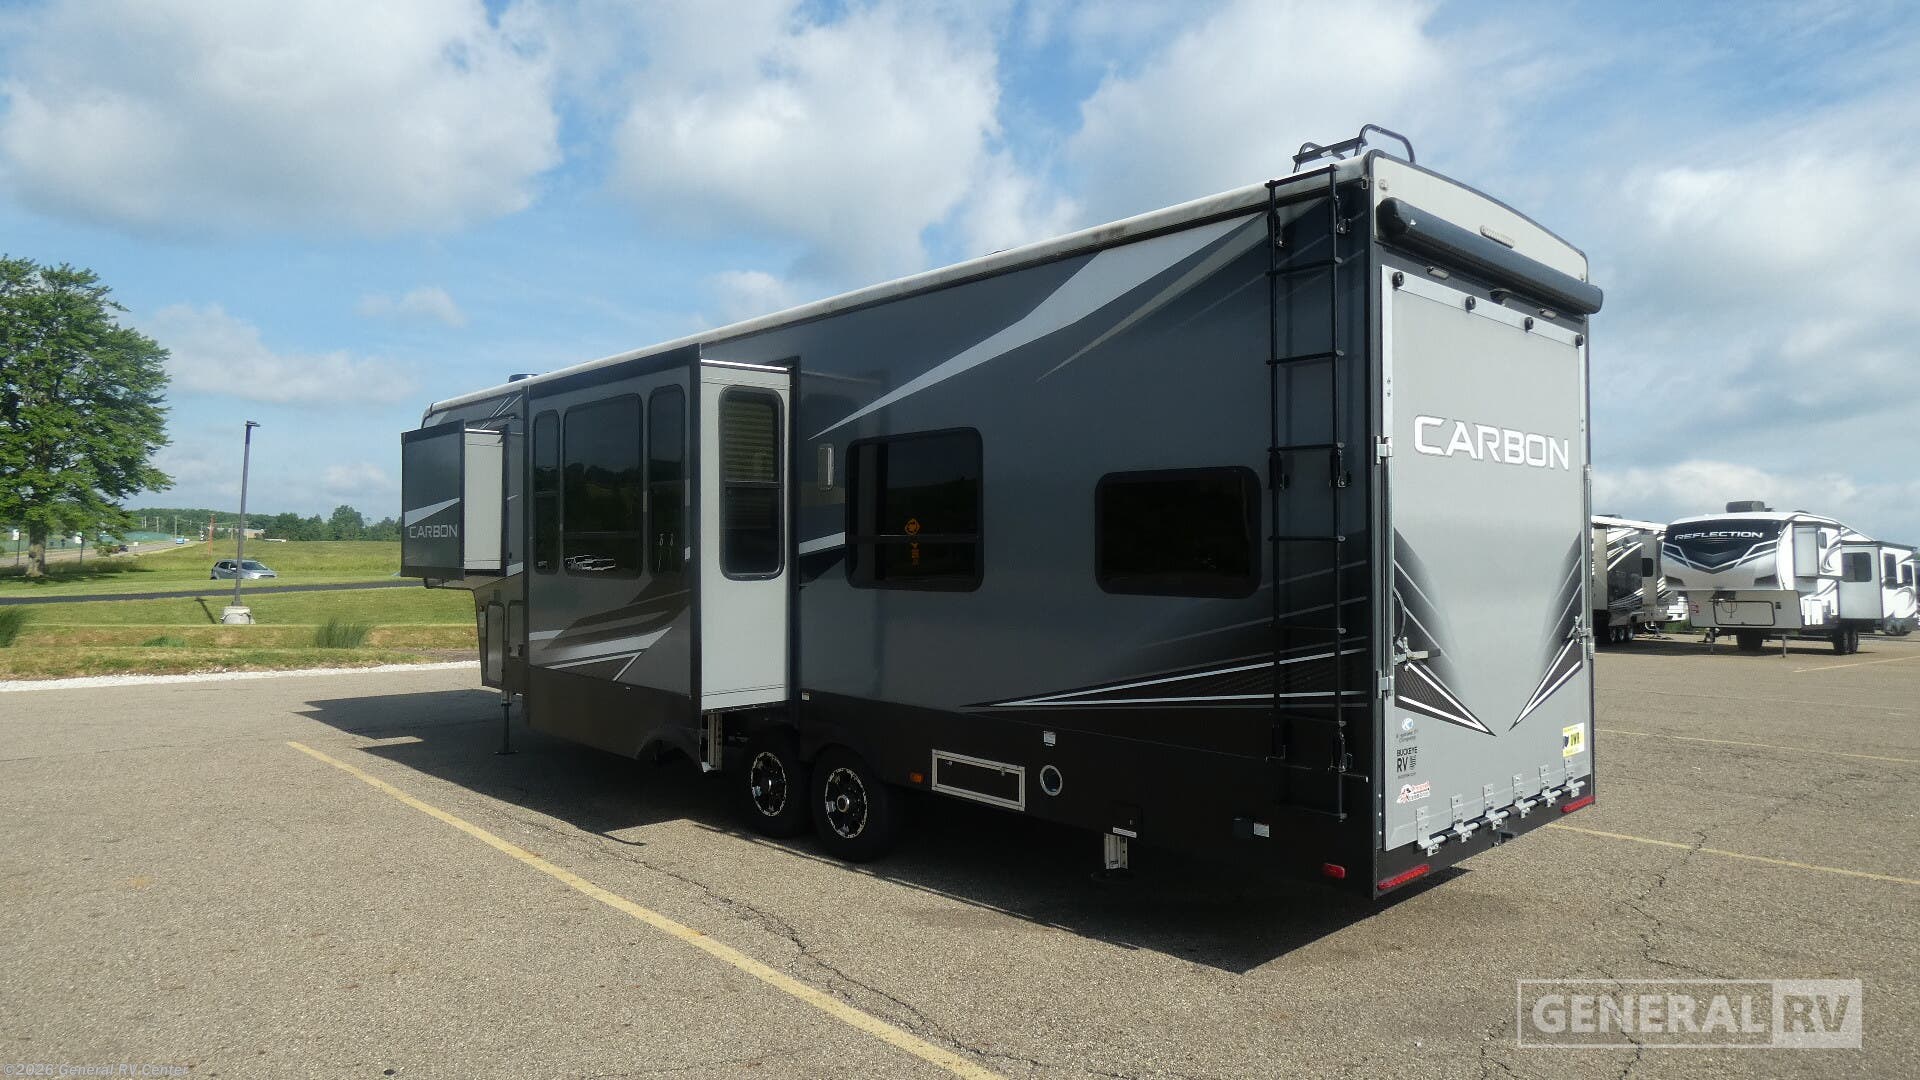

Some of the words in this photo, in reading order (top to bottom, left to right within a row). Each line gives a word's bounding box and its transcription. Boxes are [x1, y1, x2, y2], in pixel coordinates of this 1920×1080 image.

[1414, 415, 1569, 470] CARBON
[409, 524, 458, 538] CARBON
[1674, 531, 1764, 541] REFLECTION
[1396, 756, 1408, 773] RV
